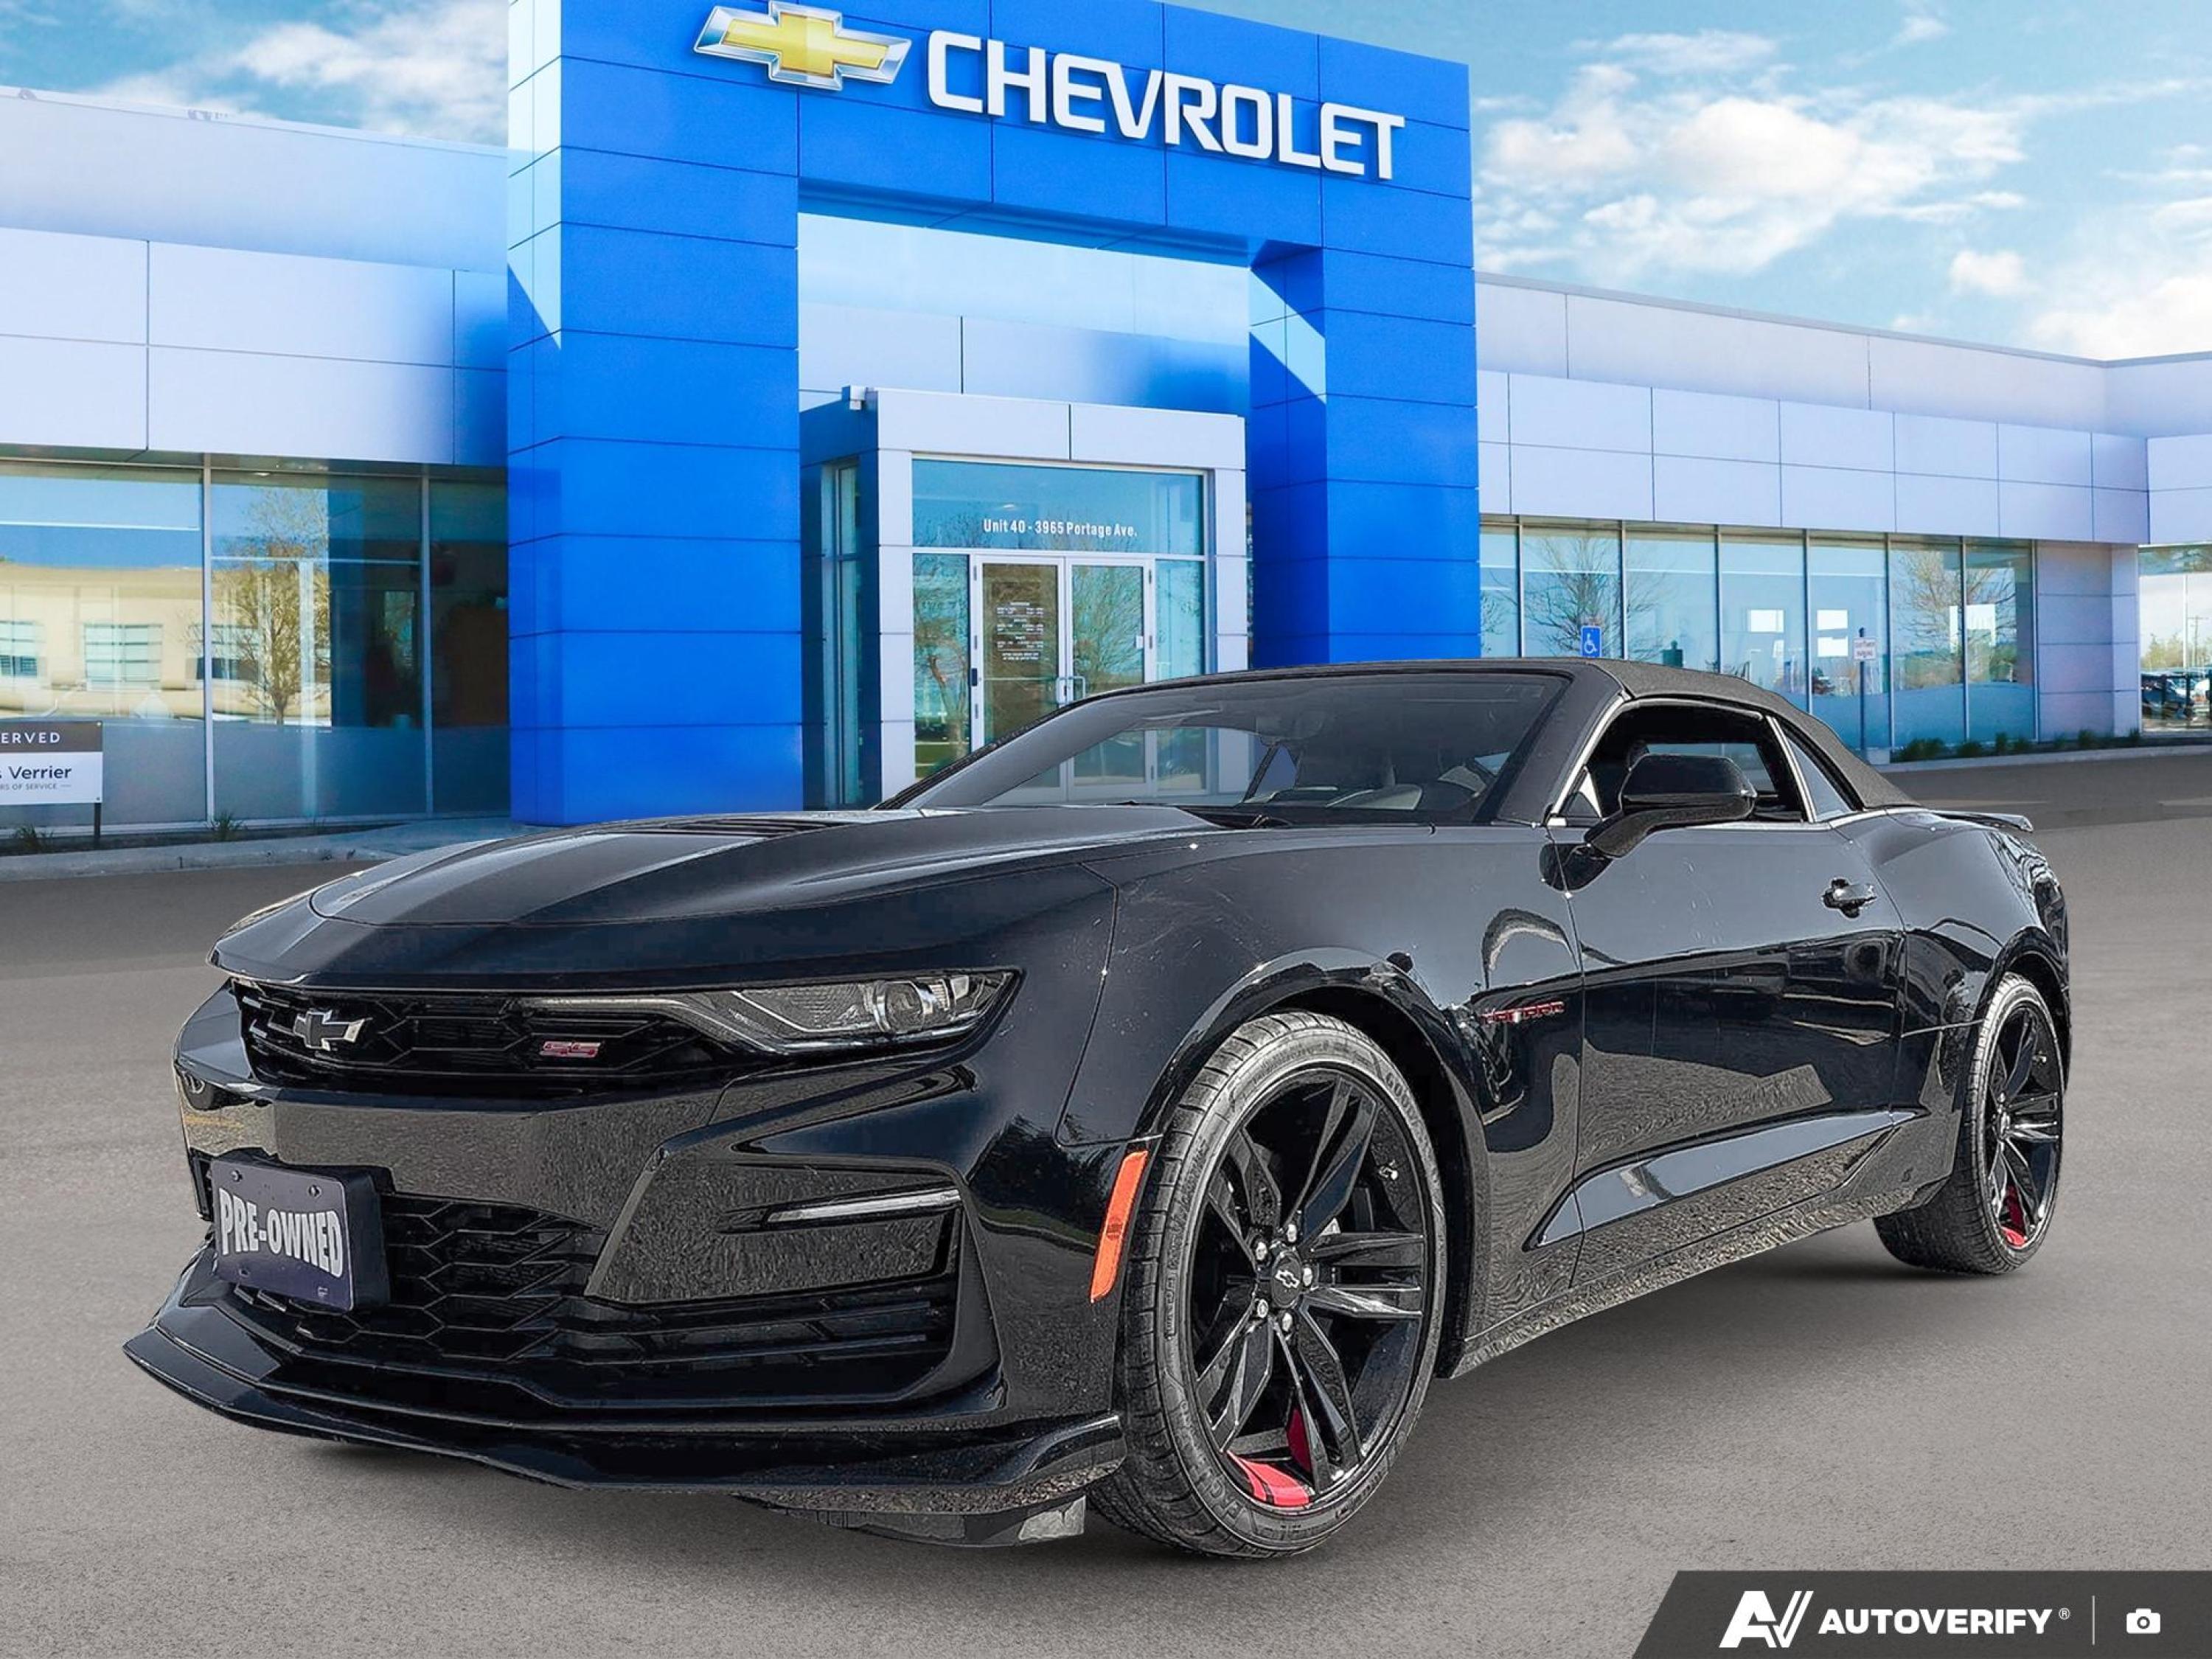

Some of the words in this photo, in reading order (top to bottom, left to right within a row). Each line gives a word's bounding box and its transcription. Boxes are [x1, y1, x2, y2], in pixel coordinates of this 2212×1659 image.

[928, 29, 1405, 180] CHEVROLET
[983, 518, 1008, 532] Unit
[1009, 519, 1026, 534] 40
[1034, 520, 1064, 535] 3965
[1066, 521, 1112, 539] Portage
[1113, 523, 1138, 538] Ave.
[8, 765, 72, 779] Verrier
[25, 783, 57, 791] SERVICE
[218, 1187, 344, 1278] PRE-OWNED
